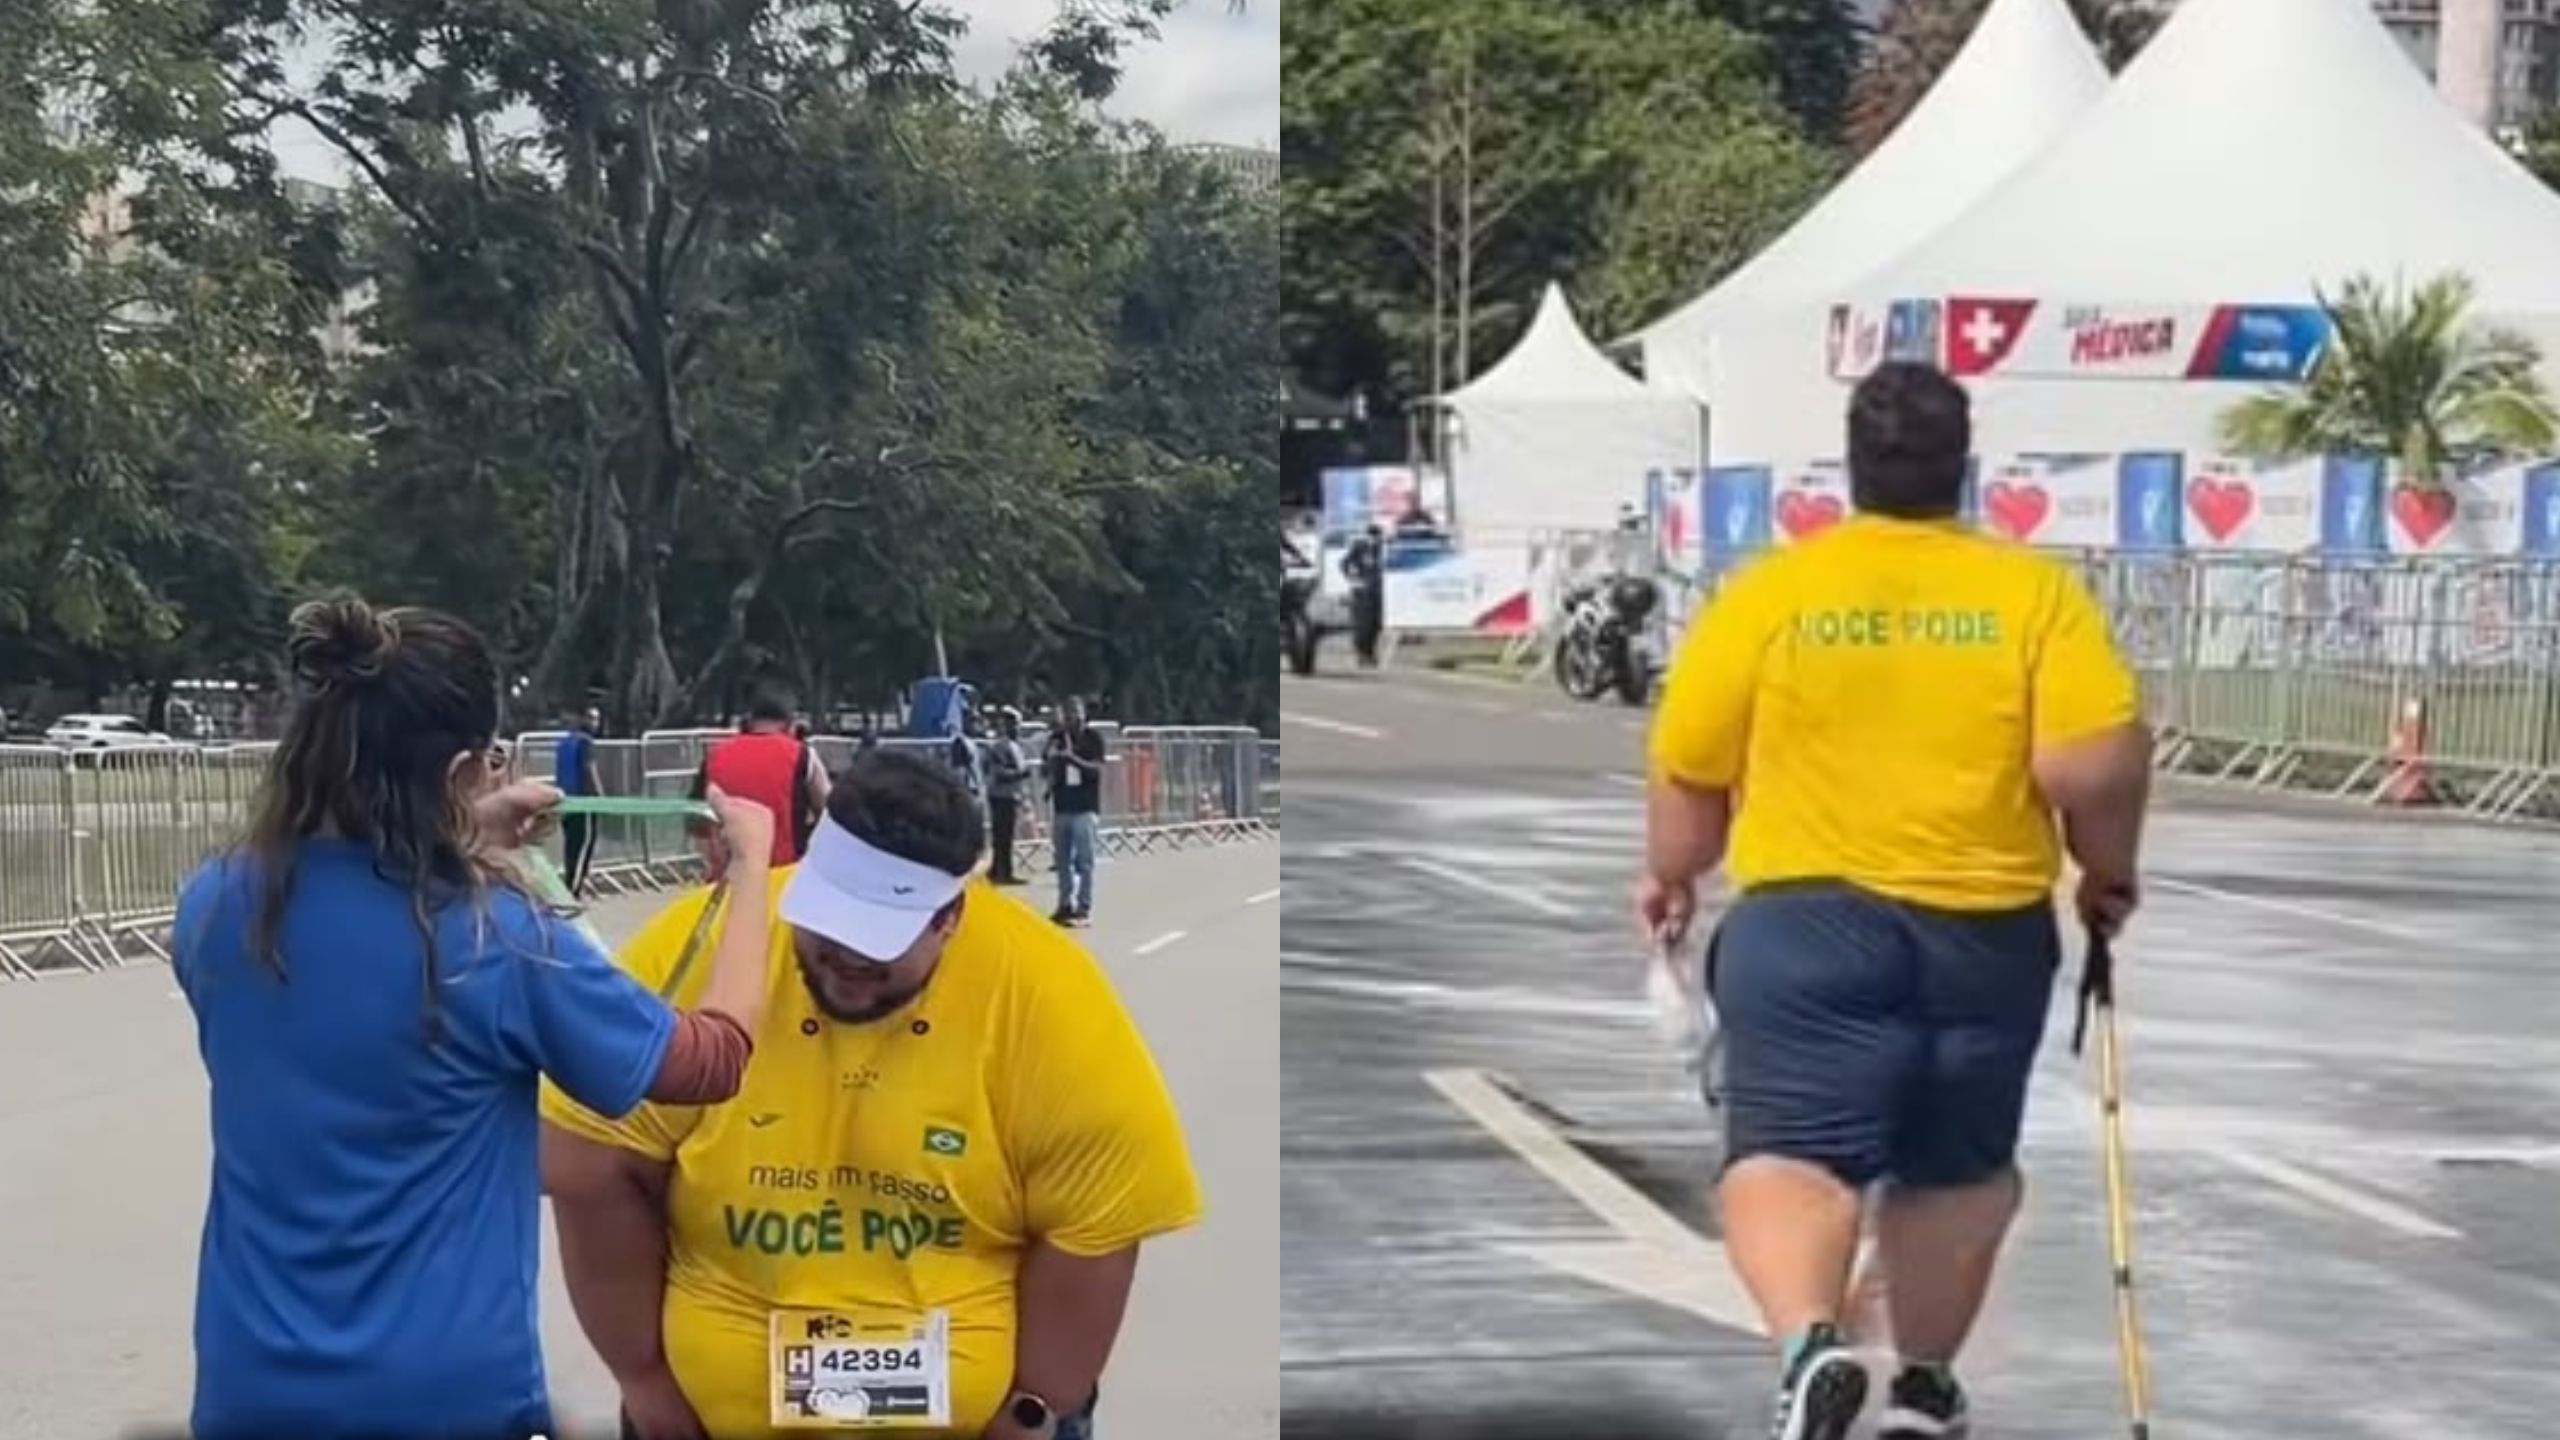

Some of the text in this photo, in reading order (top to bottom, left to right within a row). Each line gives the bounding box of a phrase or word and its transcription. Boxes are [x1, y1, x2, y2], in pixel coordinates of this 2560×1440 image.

[1902, 608, 2001, 646] PODE
[749, 1164, 818, 1189] mais
[724, 1199, 965, 1260] VOCÊ PODE
[821, 1348, 922, 1372] 42394
